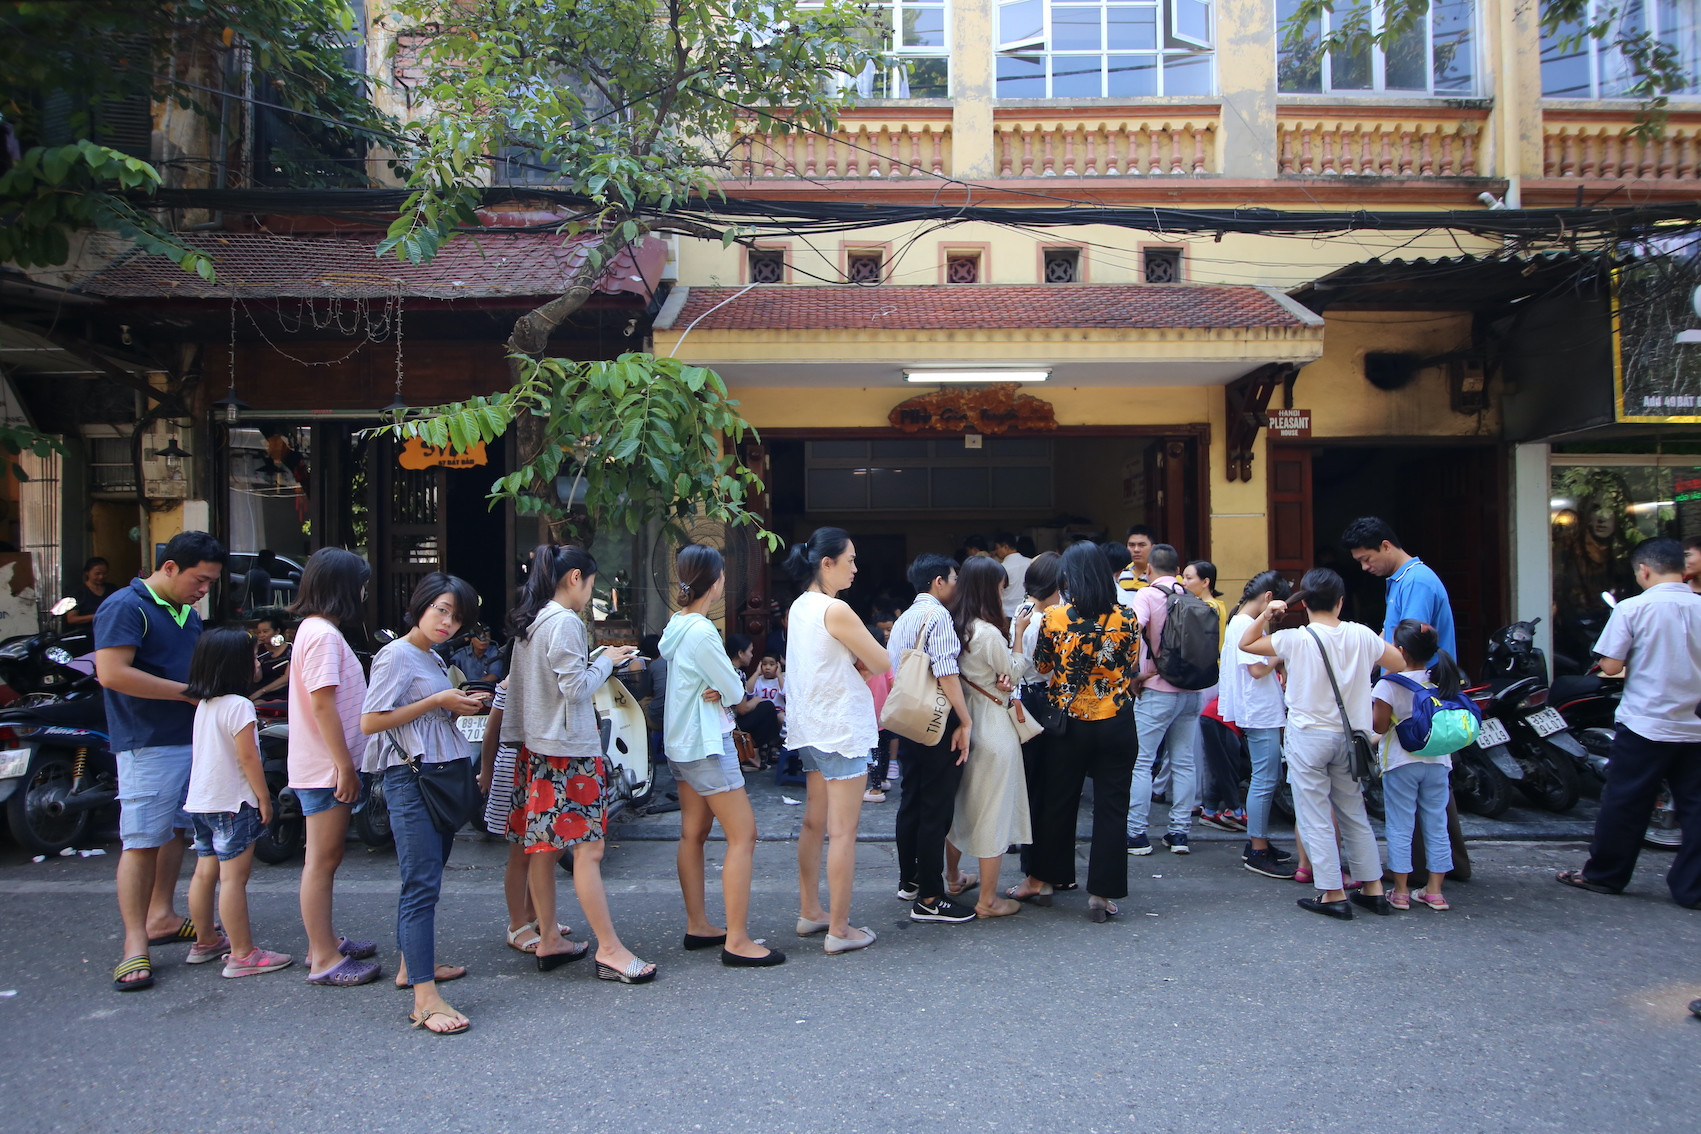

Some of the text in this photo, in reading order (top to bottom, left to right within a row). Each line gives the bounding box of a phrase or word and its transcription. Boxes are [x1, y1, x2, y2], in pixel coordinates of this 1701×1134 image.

[1269, 417, 1309, 429] PLEASANT
[1281, 429, 1298, 437] HOUSE
[762, 688, 778, 699] 10
